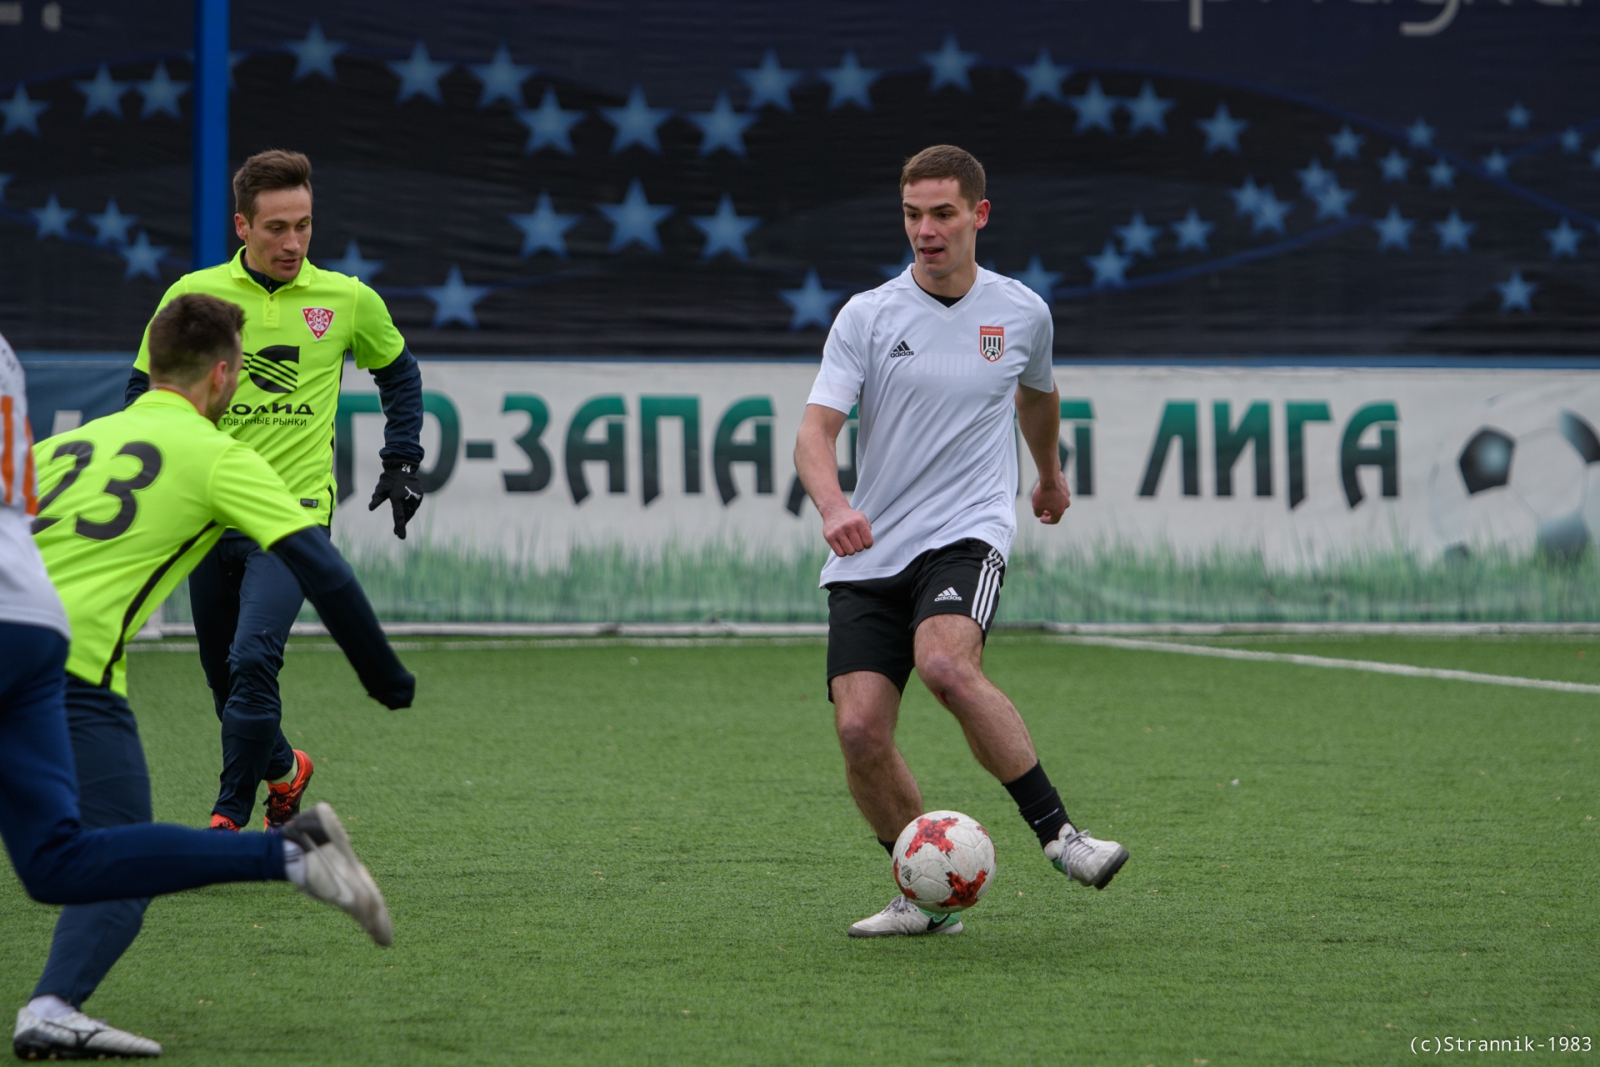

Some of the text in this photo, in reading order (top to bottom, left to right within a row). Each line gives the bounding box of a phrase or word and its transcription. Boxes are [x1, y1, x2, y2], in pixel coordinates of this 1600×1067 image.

[890, 350, 915, 358] adidas
[225, 402, 315, 416] ОЛИД
[223, 416, 307, 426] ТОВАРНЫЕ РЫНКИ
[1137, 398, 1400, 510] ЛИГА
[30, 440, 164, 541] 23
